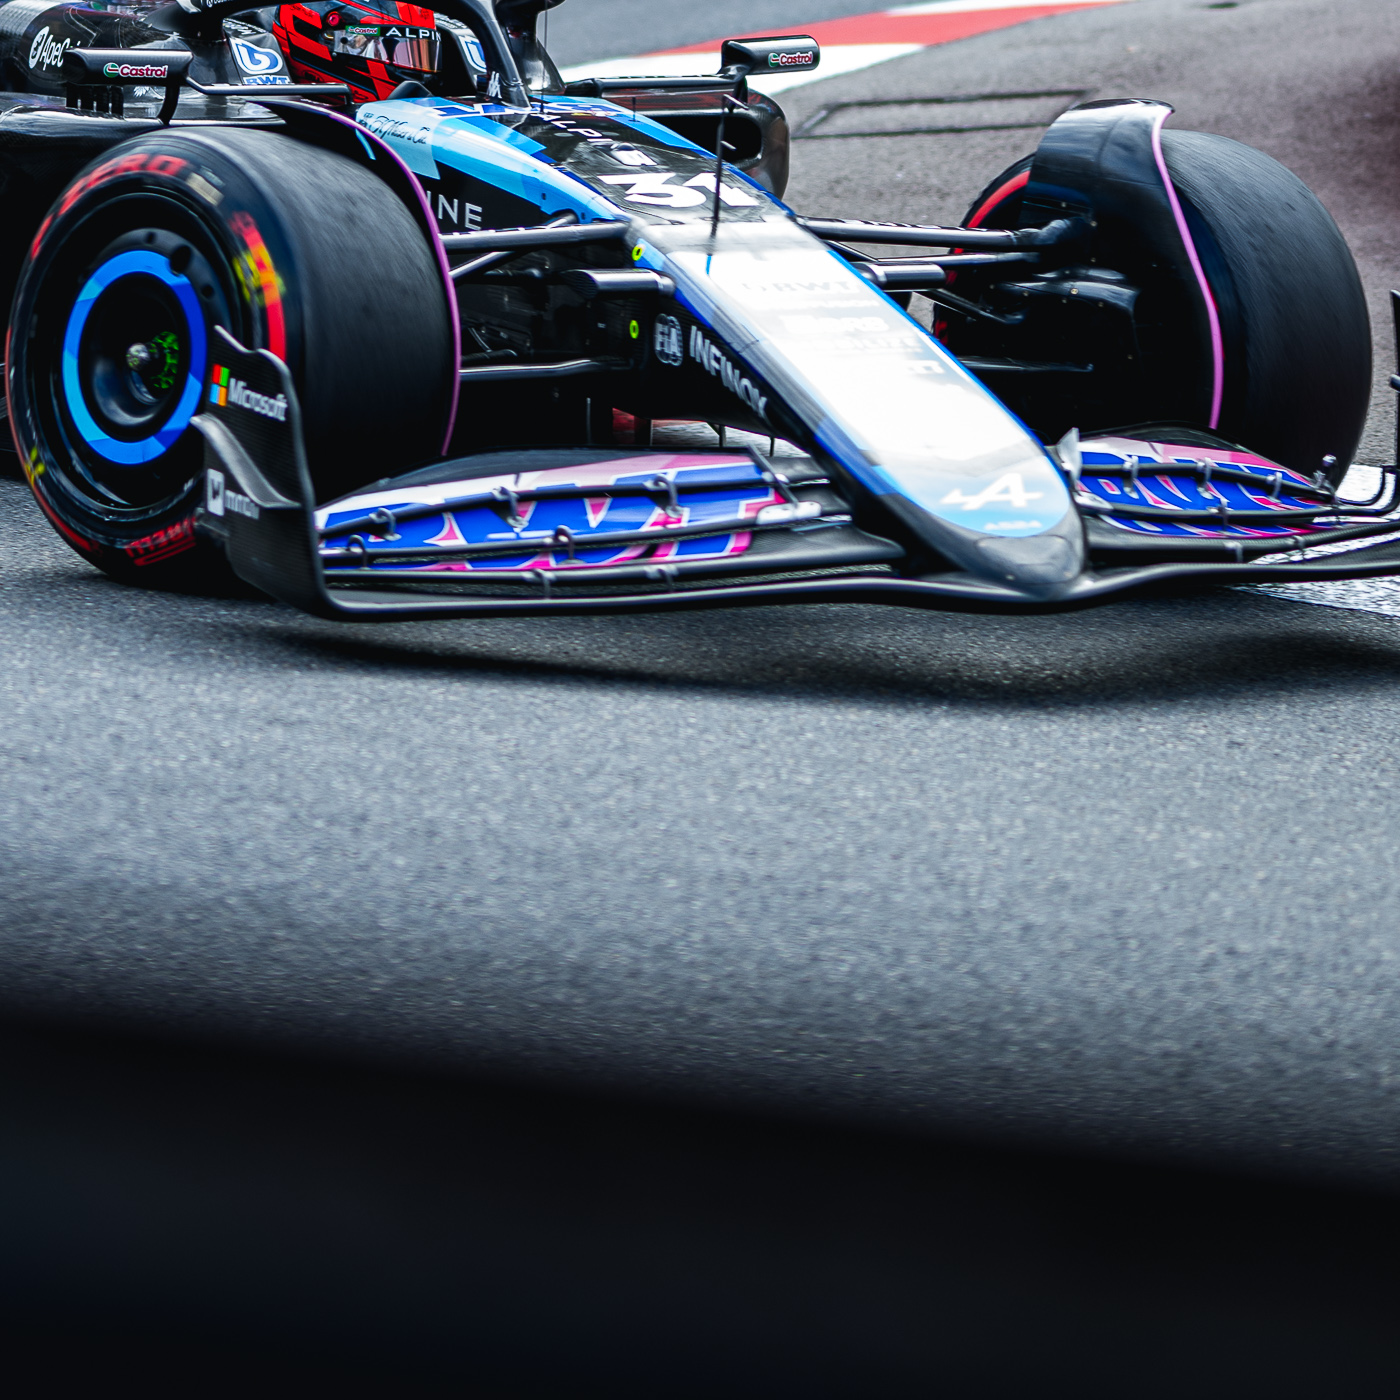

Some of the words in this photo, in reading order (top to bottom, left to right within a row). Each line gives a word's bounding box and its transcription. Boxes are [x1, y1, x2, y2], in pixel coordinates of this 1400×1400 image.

[386, 26, 441, 41] ALPIN
[779, 50, 814, 67] Castrol
[119, 63, 169, 79] Castrol
[243, 75, 291, 85] BWT
[595, 172, 758, 208] 31
[426, 190, 483, 231] INE
[227, 377, 288, 422] Microsoft
